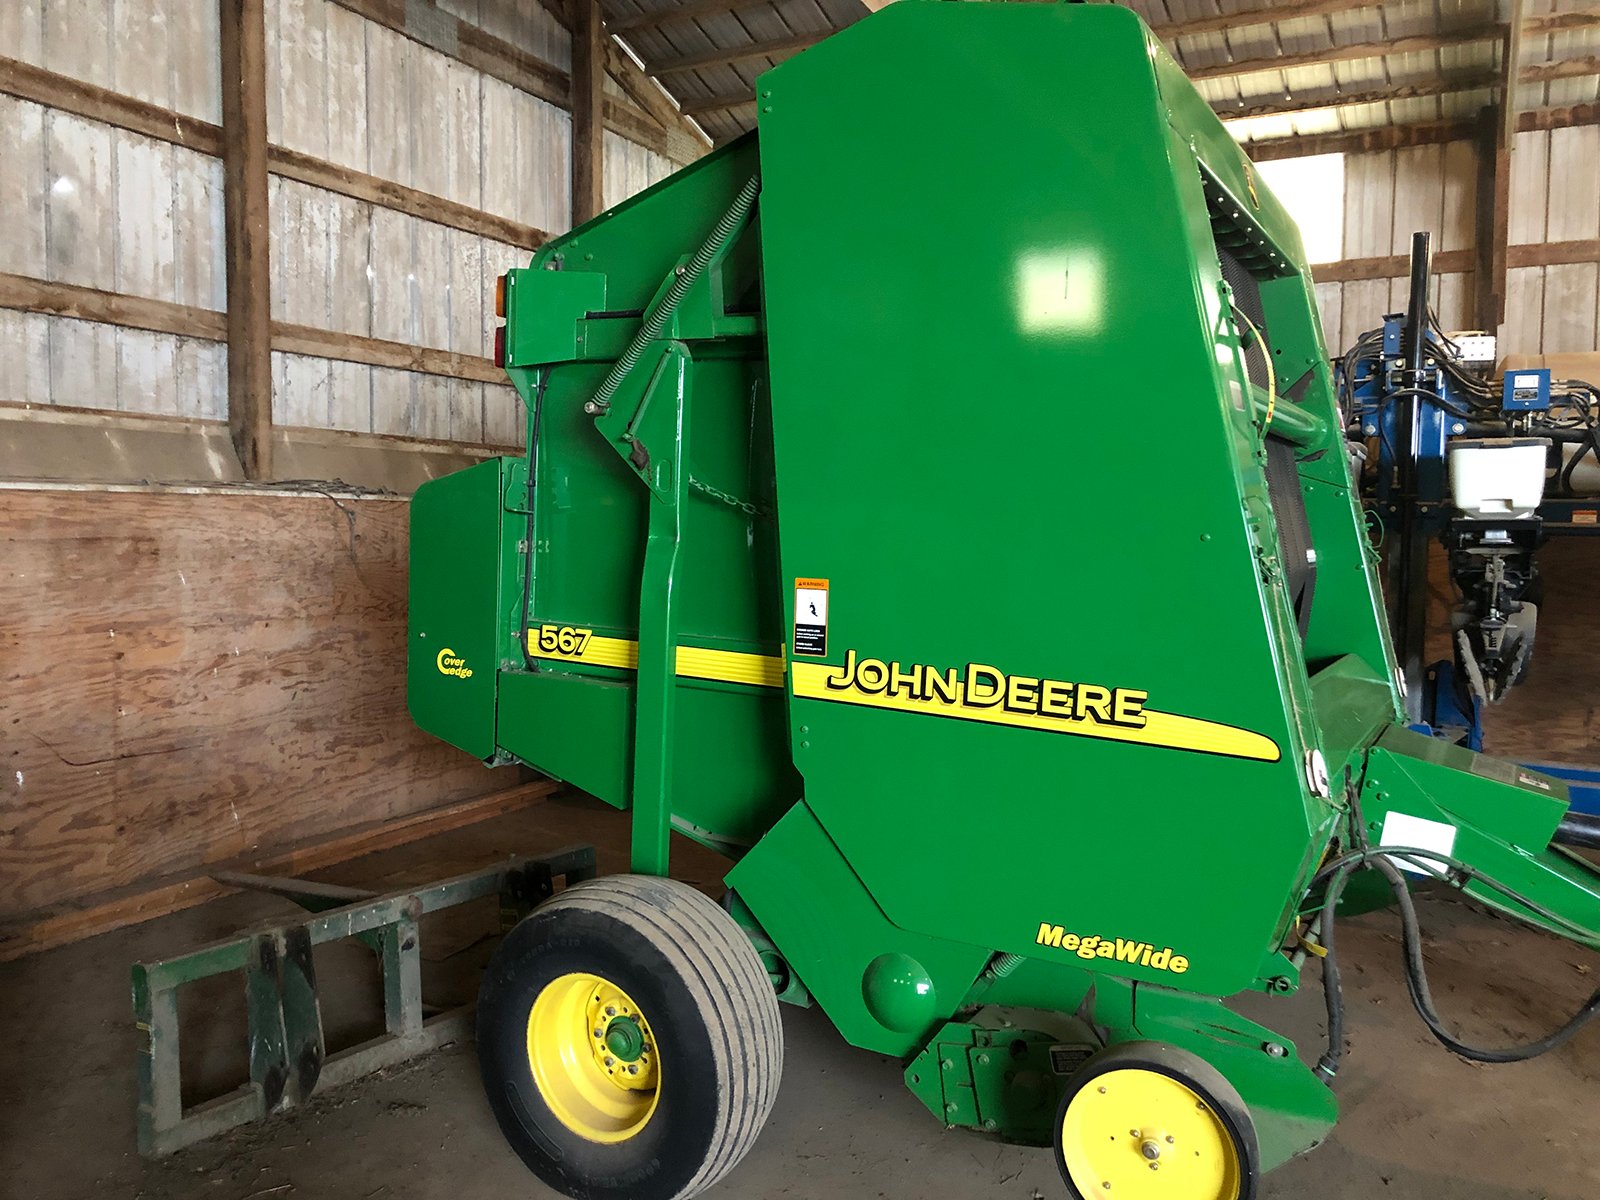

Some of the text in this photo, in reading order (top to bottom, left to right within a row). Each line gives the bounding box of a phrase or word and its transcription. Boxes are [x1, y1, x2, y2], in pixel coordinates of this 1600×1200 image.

[539, 625, 592, 656] 567
[450, 666, 472, 679] edge
[827, 649, 1148, 728] JOHN DEERE
[1036, 922, 1189, 973] MegaWide
